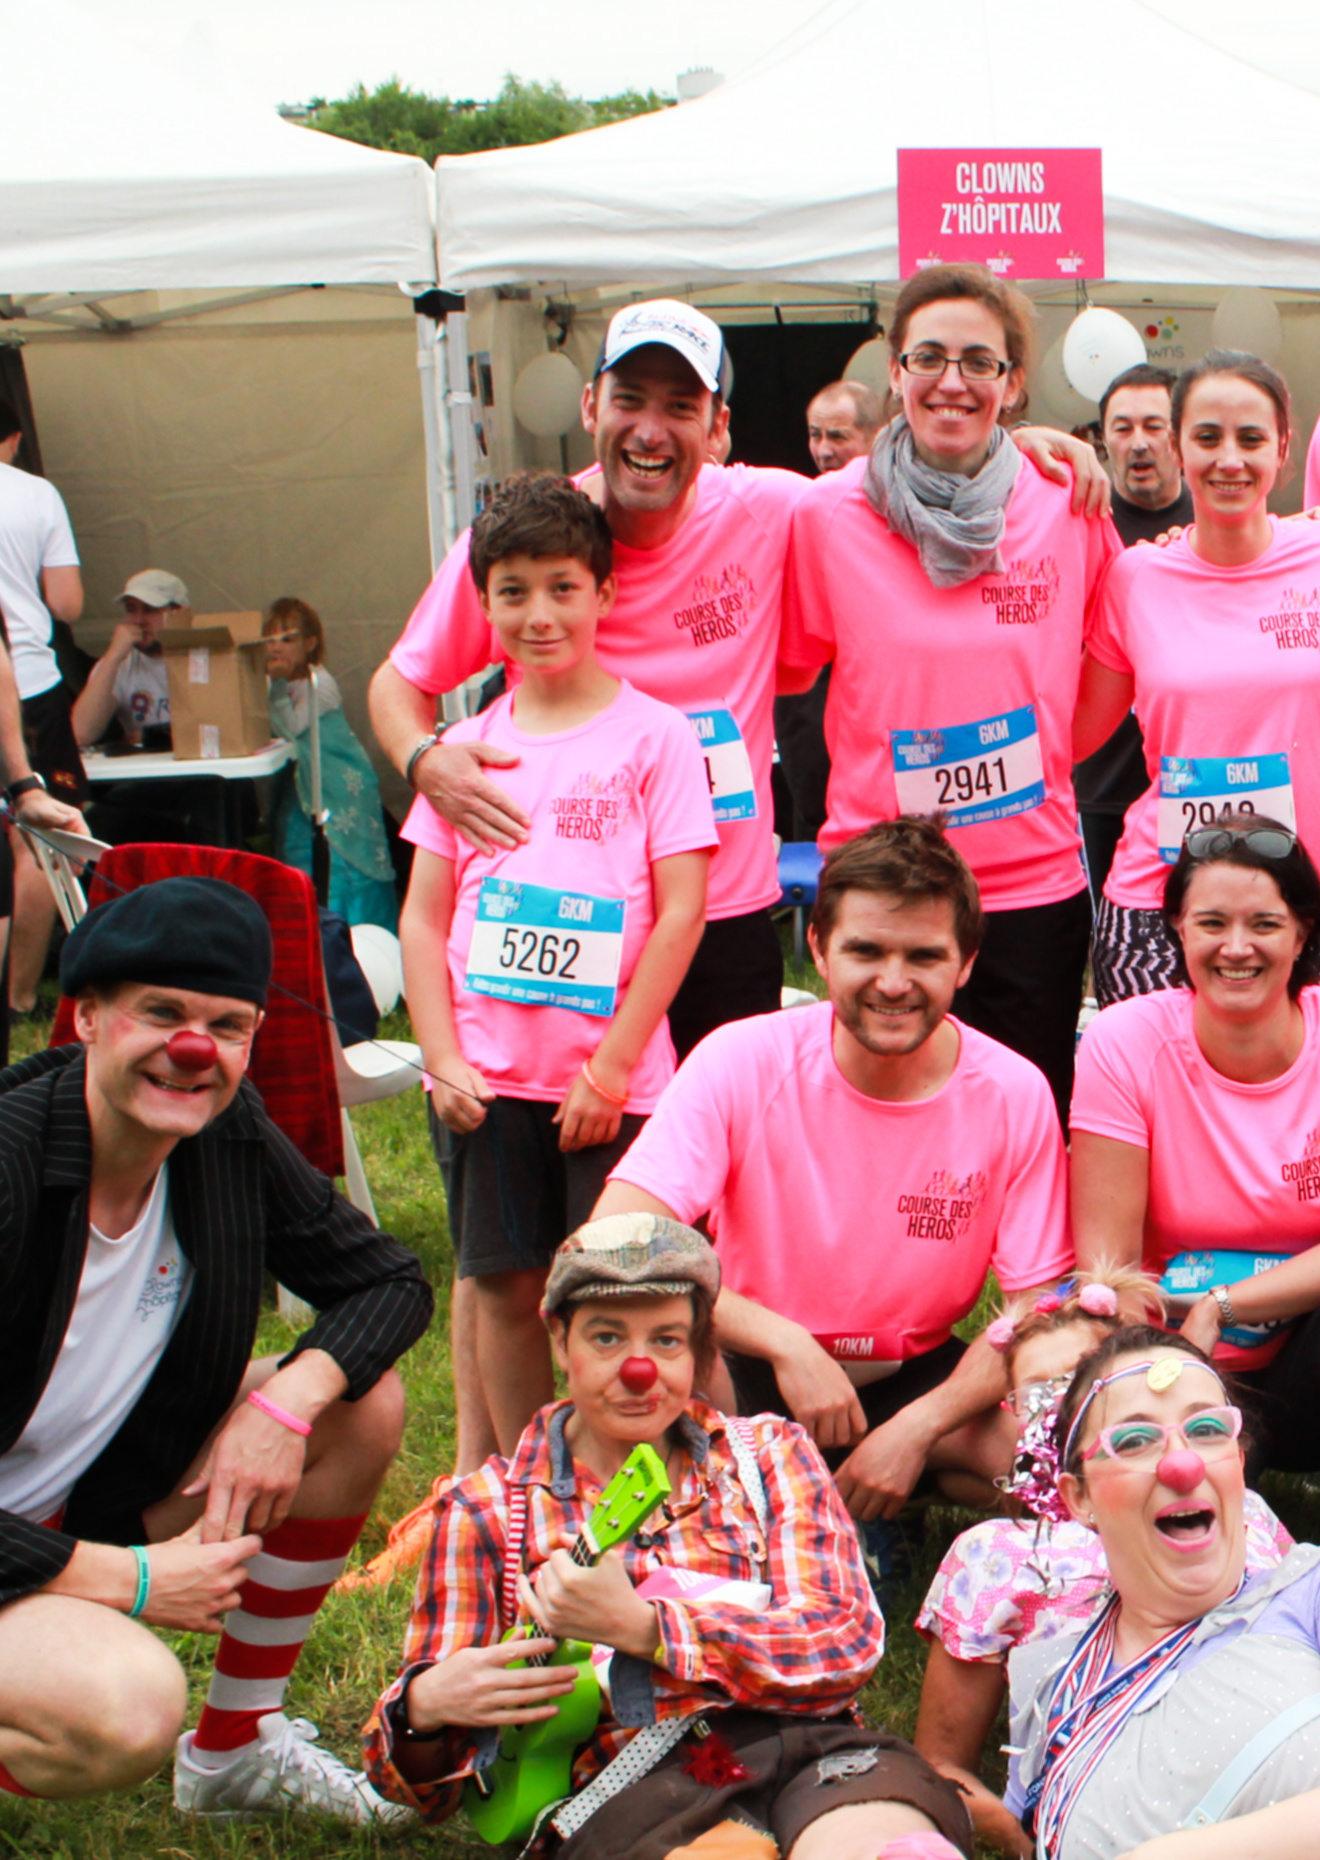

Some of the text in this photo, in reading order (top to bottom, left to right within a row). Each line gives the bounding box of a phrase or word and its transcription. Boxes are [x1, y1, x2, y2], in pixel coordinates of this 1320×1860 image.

[956, 162, 1045, 194] CLOWNS
[940, 195, 1062, 234] Z'HÔPITAUX
[981, 584, 1050, 604] COURSE DES
[673, 593, 743, 630] COURSE DES
[996, 602, 1037, 625] HEROS
[1258, 612, 1304, 633] COURSE
[691, 614, 737, 647] HEROS
[1275, 628, 1319, 650] HEROS
[689, 716, 715, 739] KM
[978, 718, 1009, 745] 6KM
[935, 756, 1007, 805] 2941
[1226, 761, 1259, 785] 6KM
[596, 800, 618, 819] DES
[555, 816, 604, 841] HEROS
[557, 896, 594, 923] 6KM
[499, 928, 581, 980] 5262
[897, 1195, 974, 1219] COURSE DES
[906, 1215, 957, 1241] HEROS
[833, 1337, 874, 1355] 10KM
